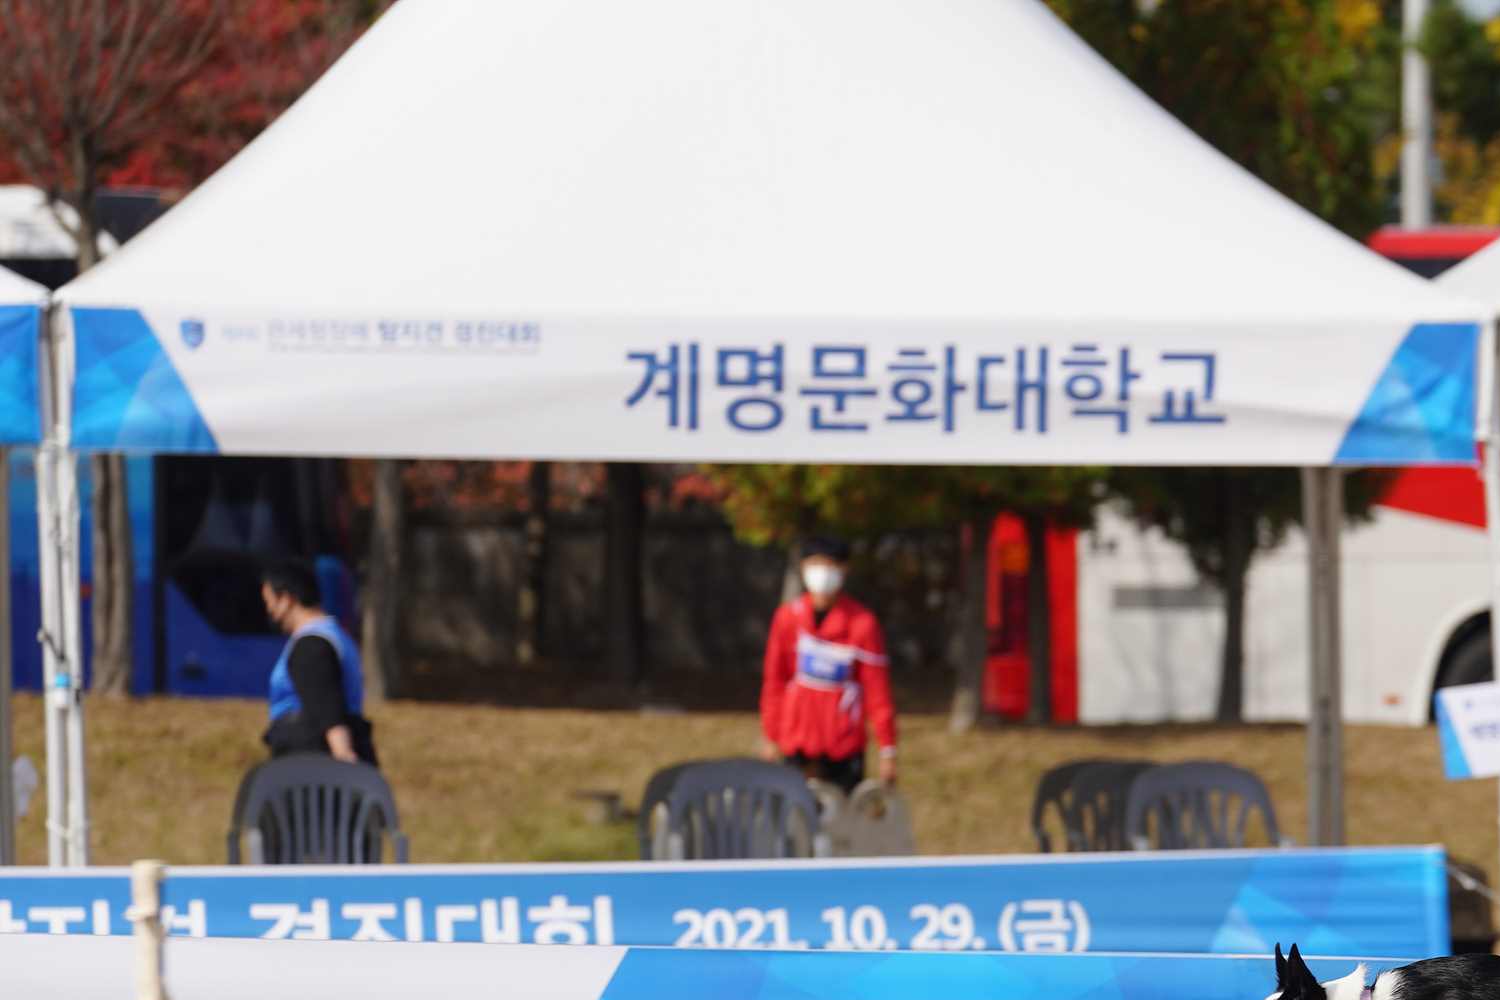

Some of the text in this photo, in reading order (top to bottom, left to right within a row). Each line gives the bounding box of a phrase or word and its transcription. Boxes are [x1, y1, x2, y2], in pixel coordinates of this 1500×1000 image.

[625, 343, 1227, 433] 계명문화대학교
[673, 908, 808, 948] 2021.
[821, 905, 897, 949] 10.
[910, 904, 987, 949] 29.
